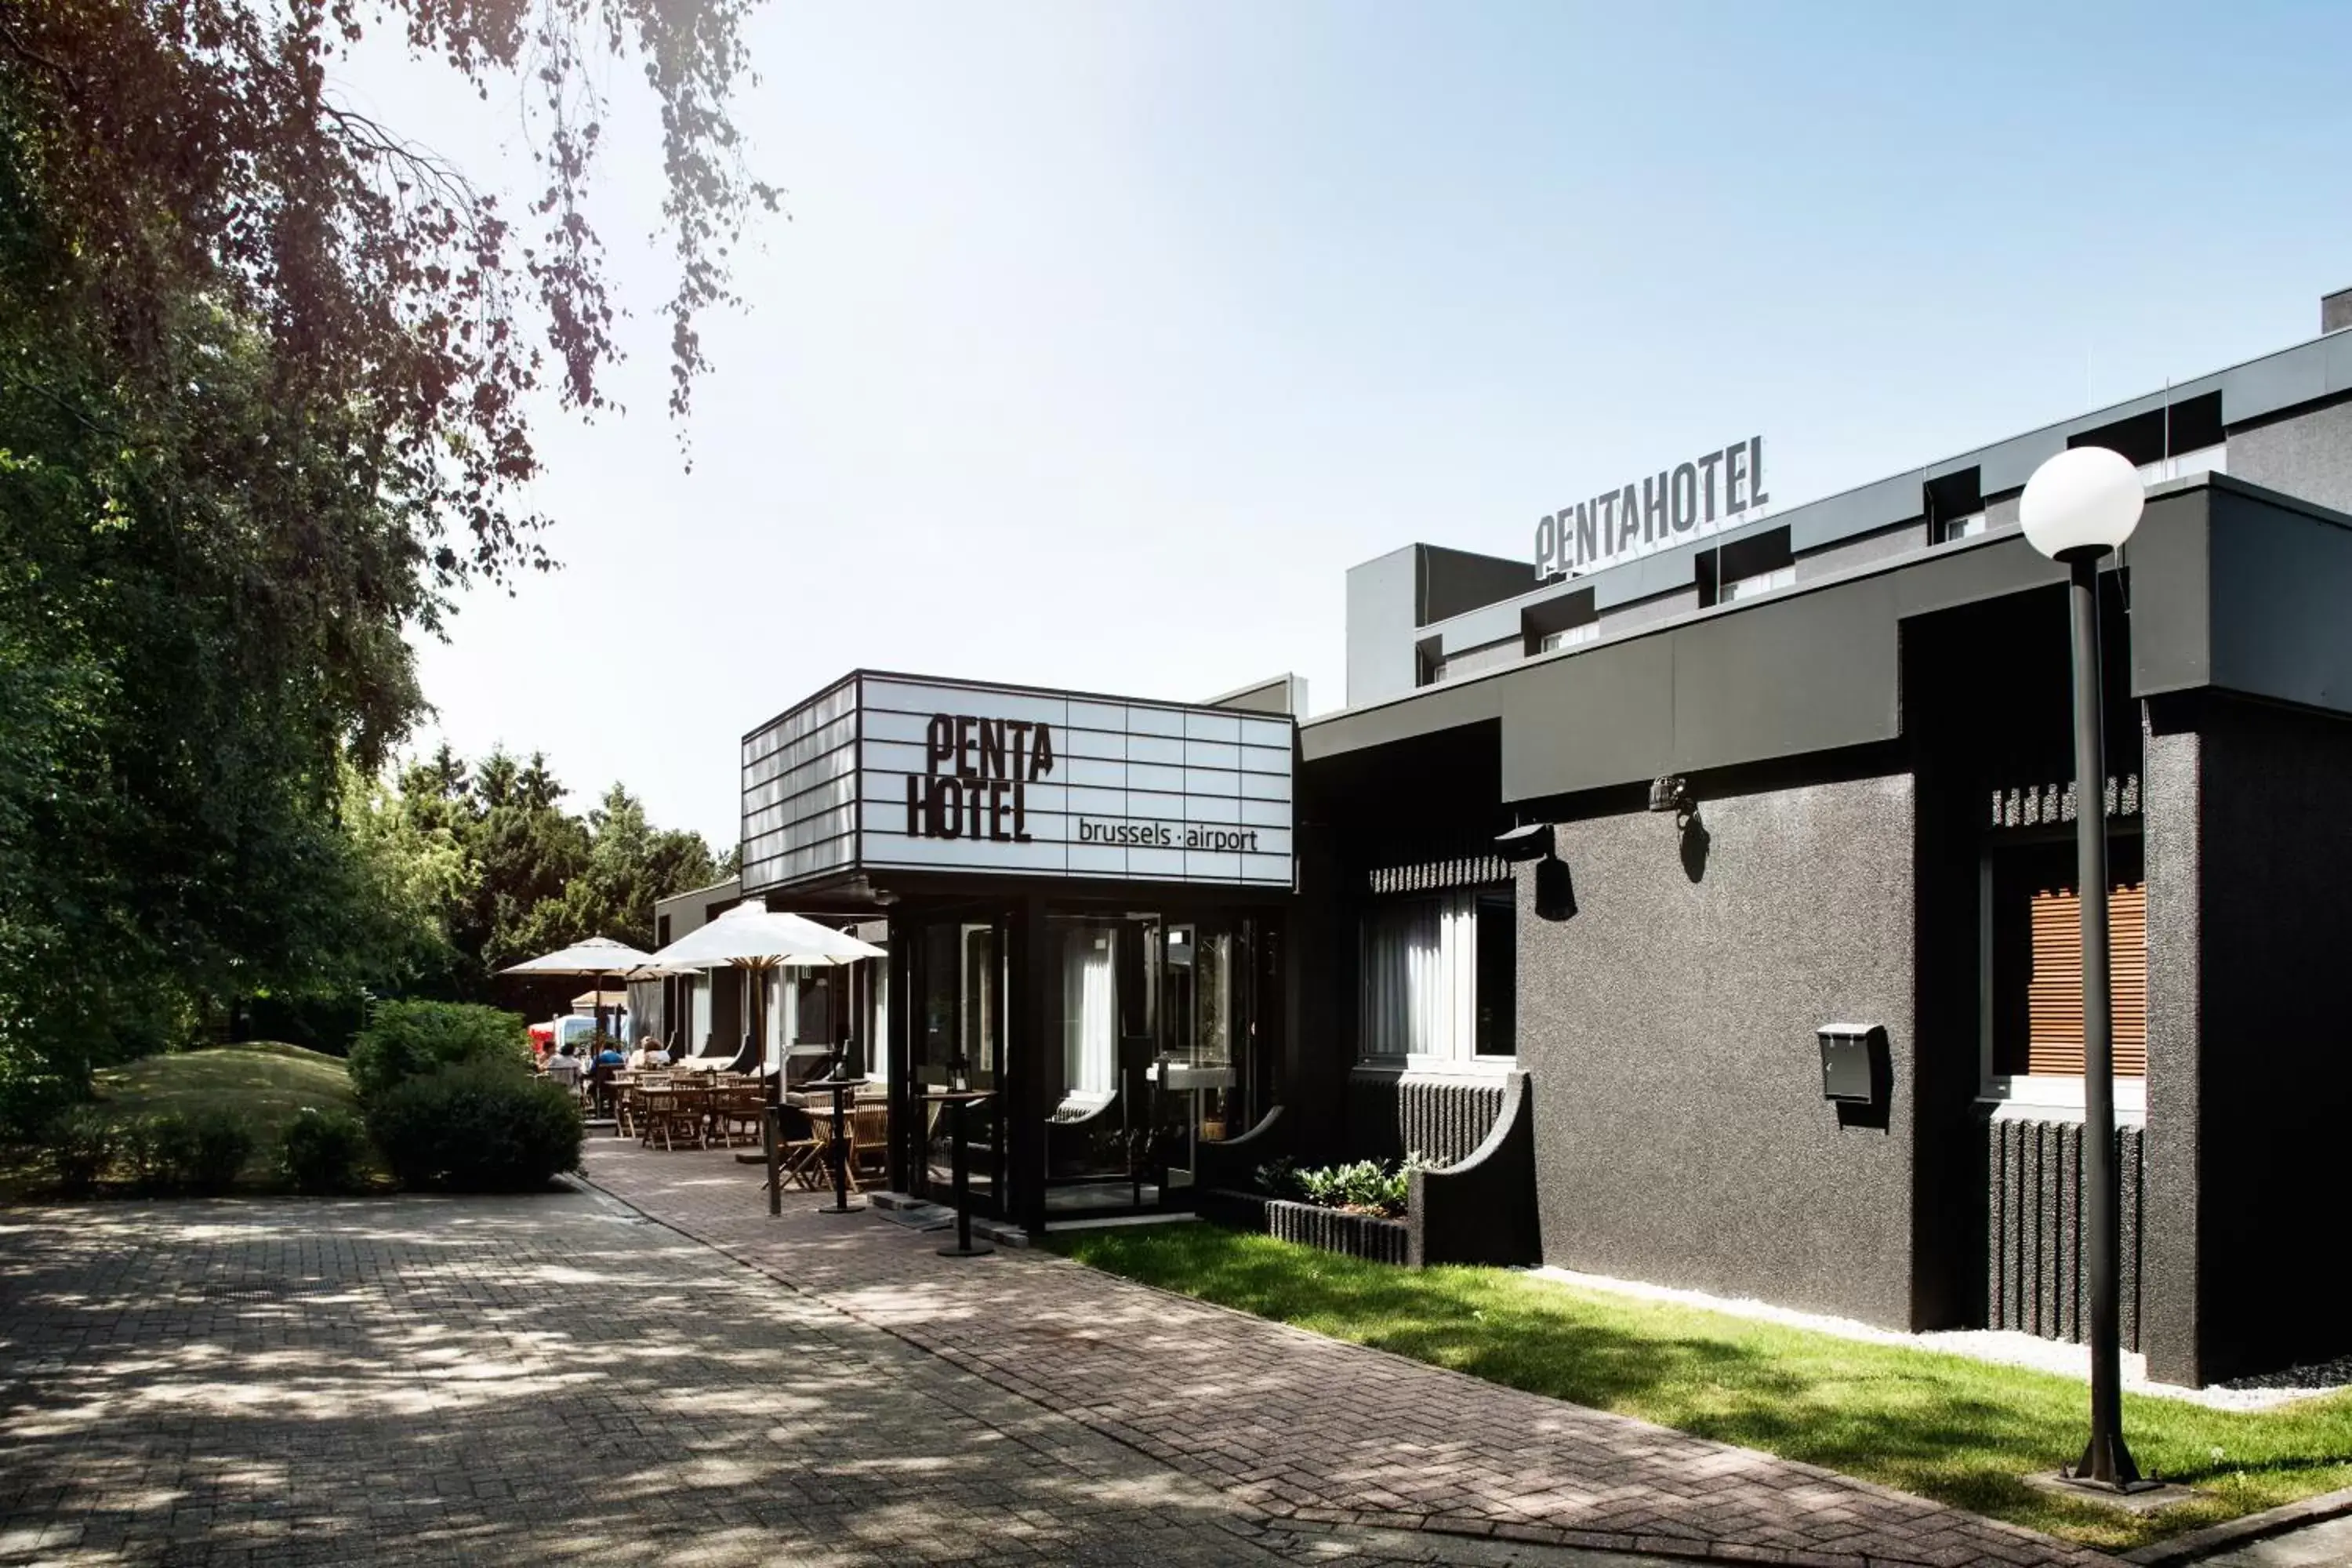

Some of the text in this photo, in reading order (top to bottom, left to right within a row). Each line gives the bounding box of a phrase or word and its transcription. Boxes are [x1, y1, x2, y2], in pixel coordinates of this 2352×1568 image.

[1535, 435, 1769, 581] PENTAHOTEL
[927, 713, 1054, 782] PENTA
[907, 775, 1032, 842] HOTEL
[1080, 818, 1258, 852] brussels airport
